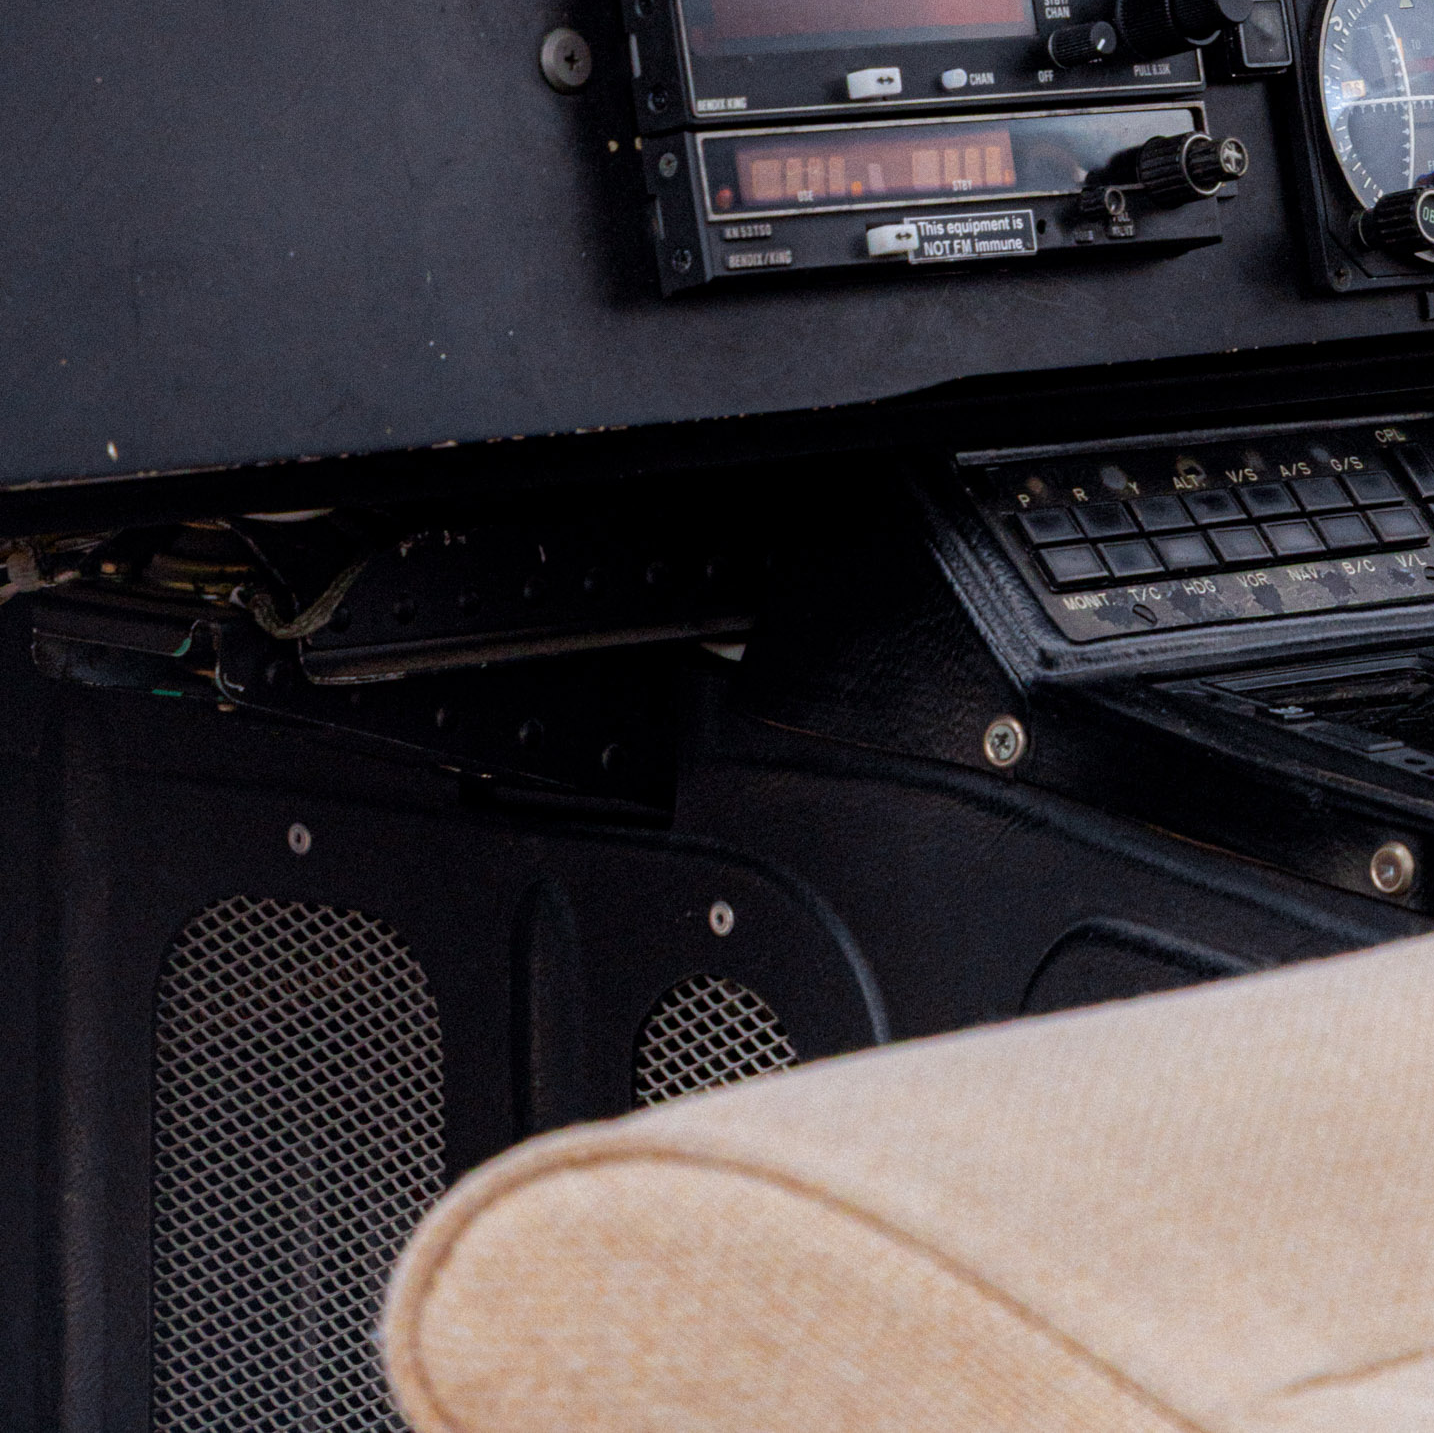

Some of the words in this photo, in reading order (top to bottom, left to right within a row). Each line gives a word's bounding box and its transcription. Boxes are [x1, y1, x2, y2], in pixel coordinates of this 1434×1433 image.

[1045, 7, 1070, 19] CHAN
[918, 221, 945, 236] This
[947, 218, 1010, 237] equipment
[1012, 216, 1024, 229] is
[924, 240, 951, 256] NOT
[953, 241, 972, 253] FM
[1182, 580, 1217, 596] HDG
[1237, 573, 1270, 587] VOR
